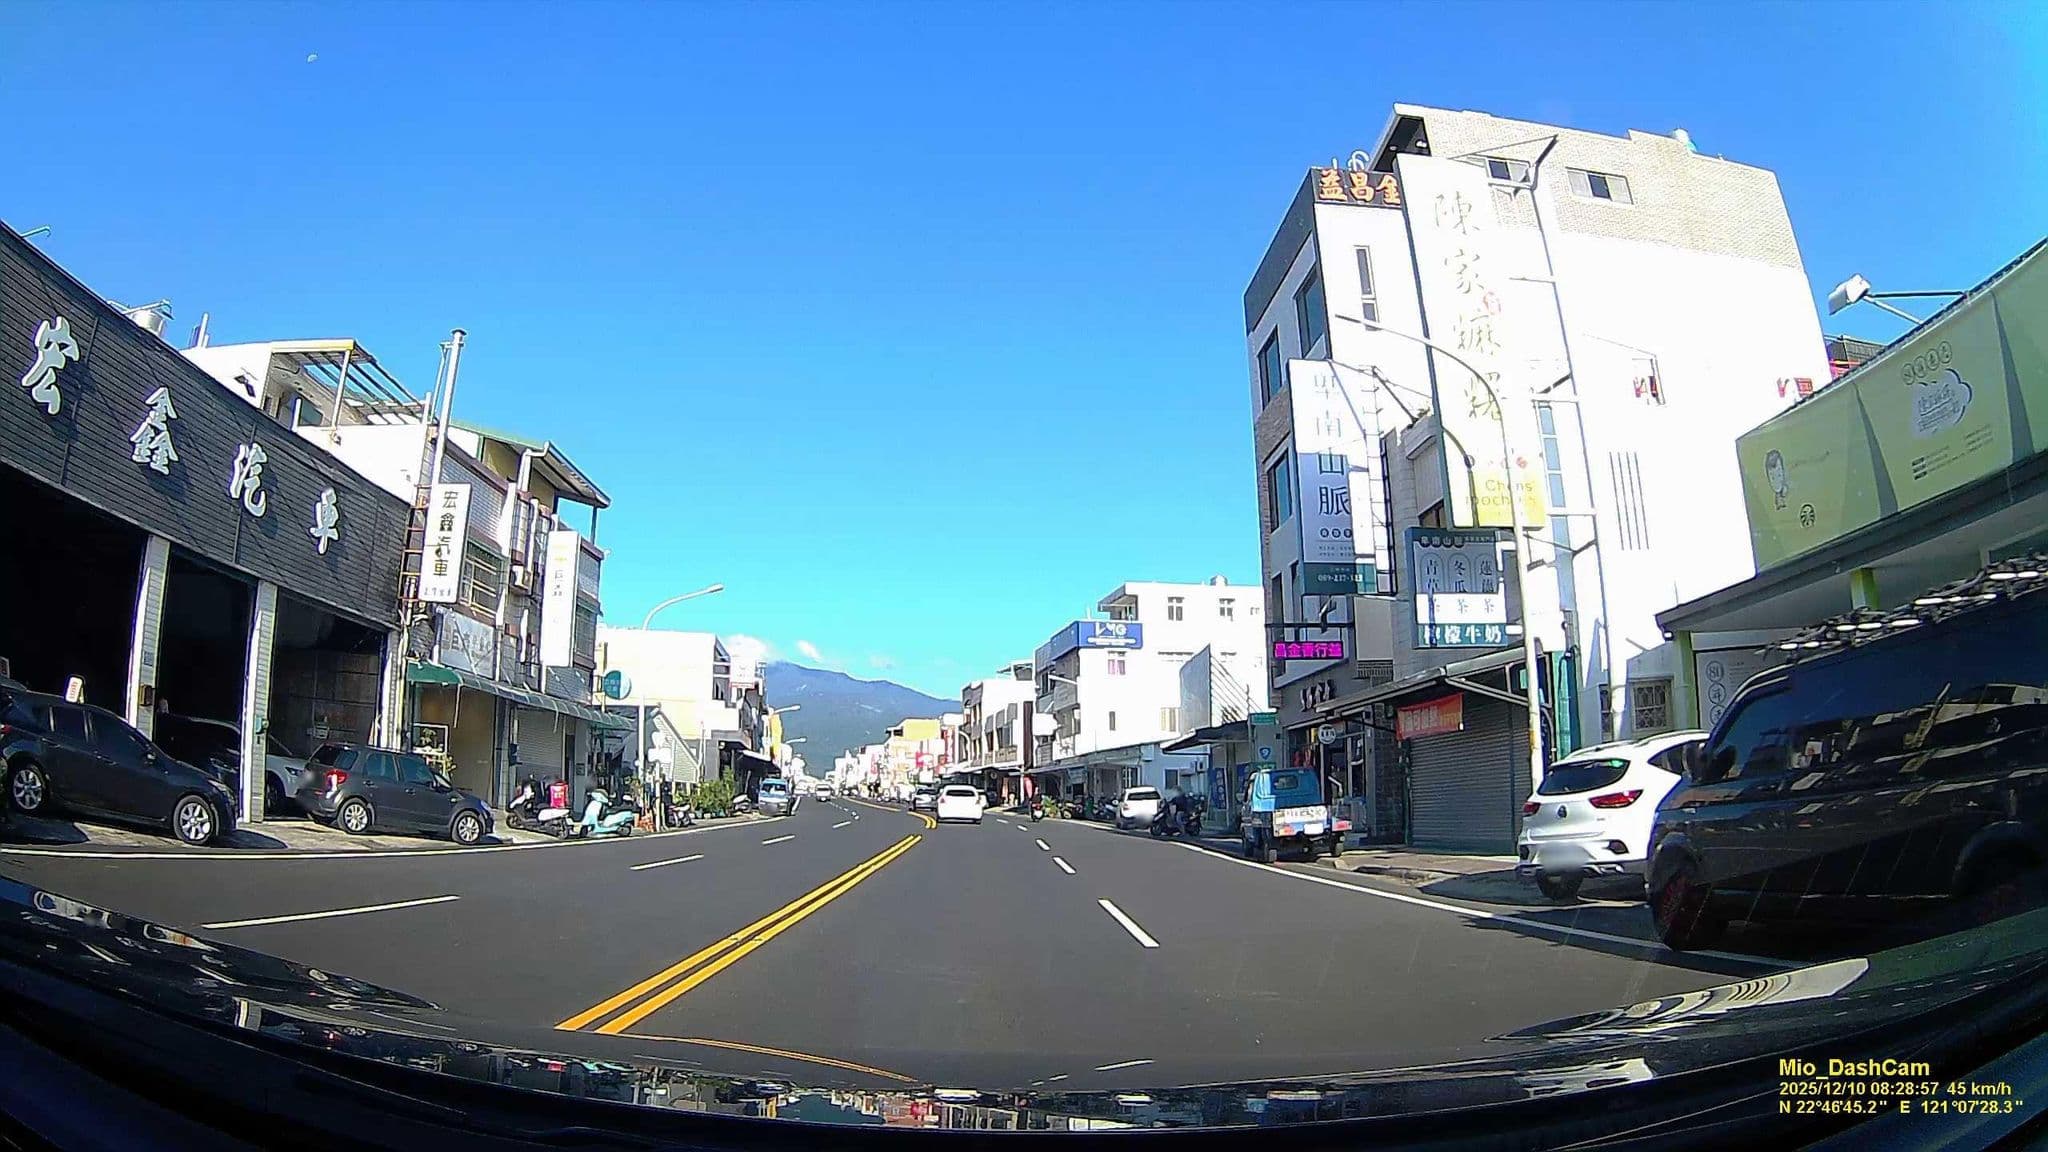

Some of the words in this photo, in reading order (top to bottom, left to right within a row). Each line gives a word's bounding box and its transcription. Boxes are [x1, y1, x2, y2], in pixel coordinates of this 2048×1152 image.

[1319, 168, 1400, 205] 益昌金
[21, 315, 341, 556] 宏鑫汽車
[433, 490, 458, 577] 宏鑫汽車
